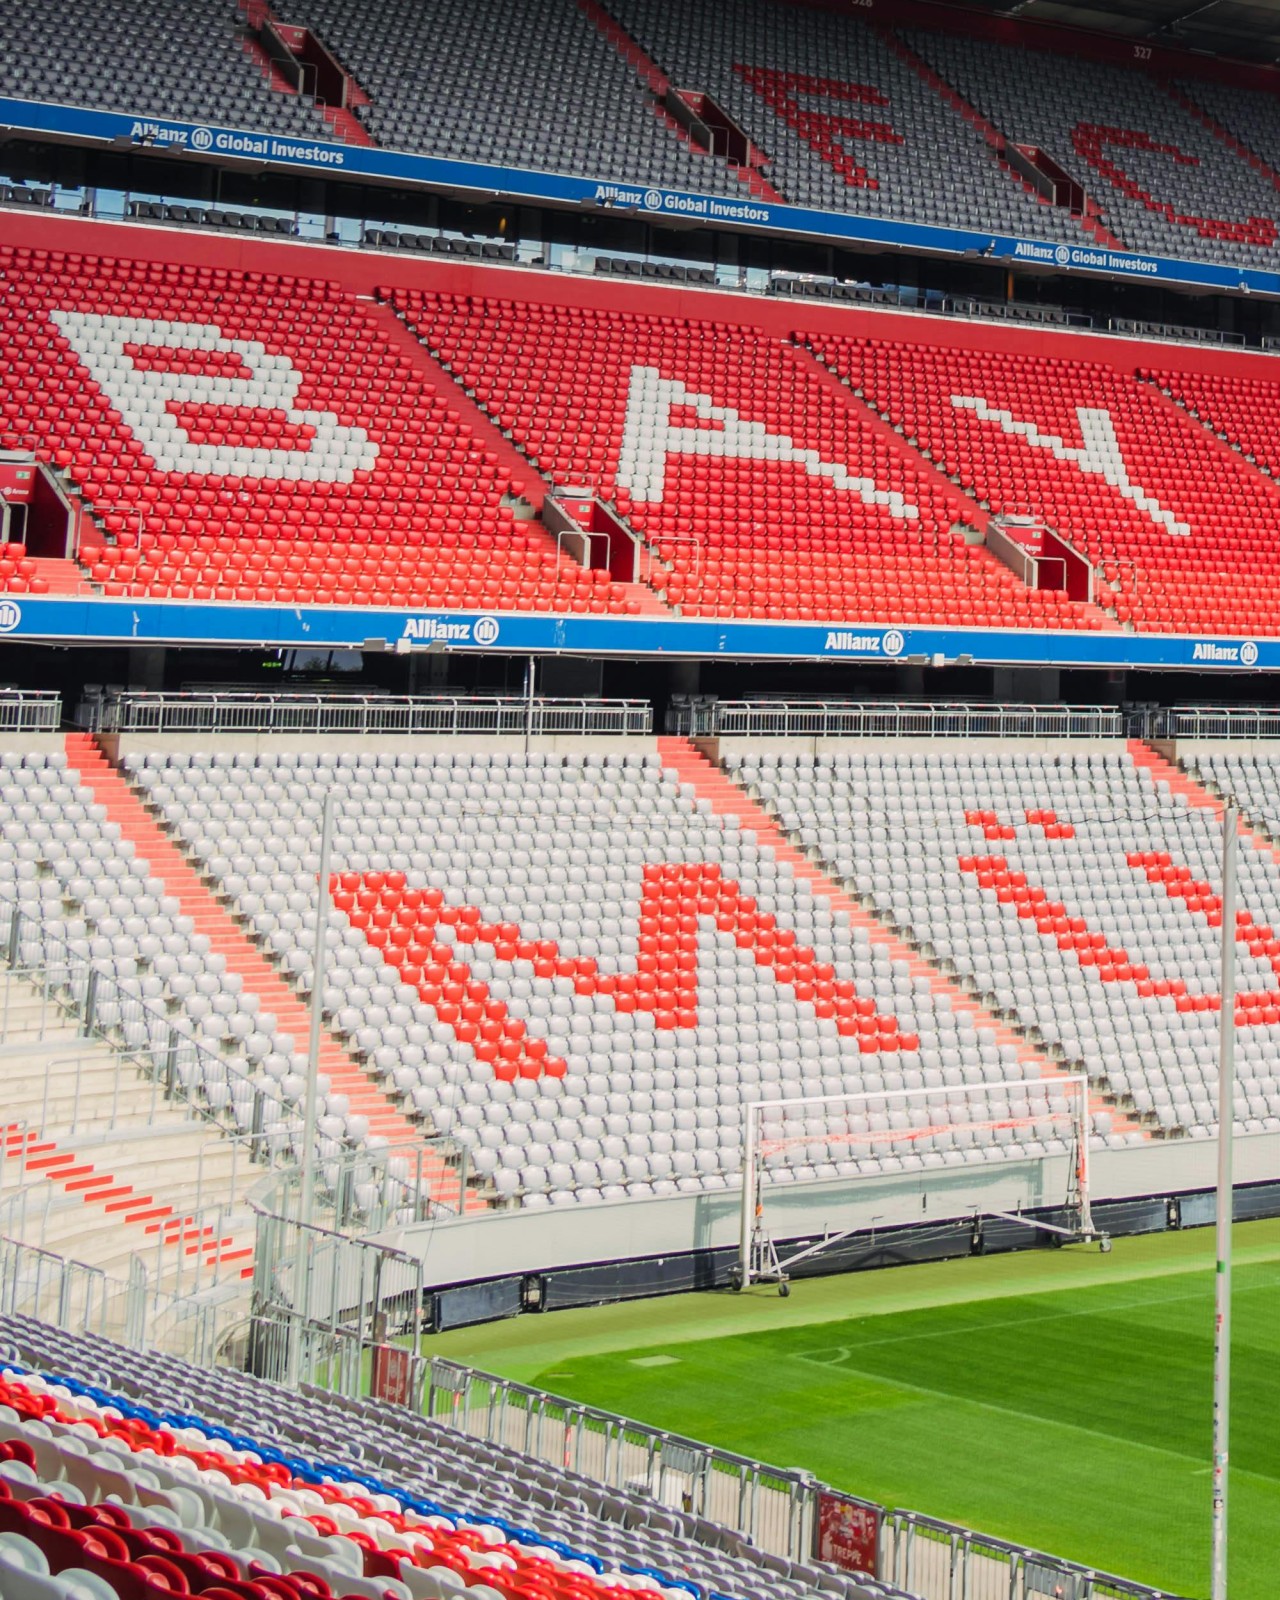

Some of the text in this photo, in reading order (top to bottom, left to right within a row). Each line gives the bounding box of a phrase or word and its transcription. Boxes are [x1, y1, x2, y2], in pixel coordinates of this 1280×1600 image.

[1133, 45, 1152, 60] 327
[130, 121, 344, 164] Allianz Global Investors
[595, 186, 770, 221] Allianz Global Investors
[1015, 242, 1158, 273] Allianz Global Investors
[403, 618, 470, 639] Allianz
[825, 632, 880, 650] Allianz
[1192, 643, 1239, 660] Allianz
